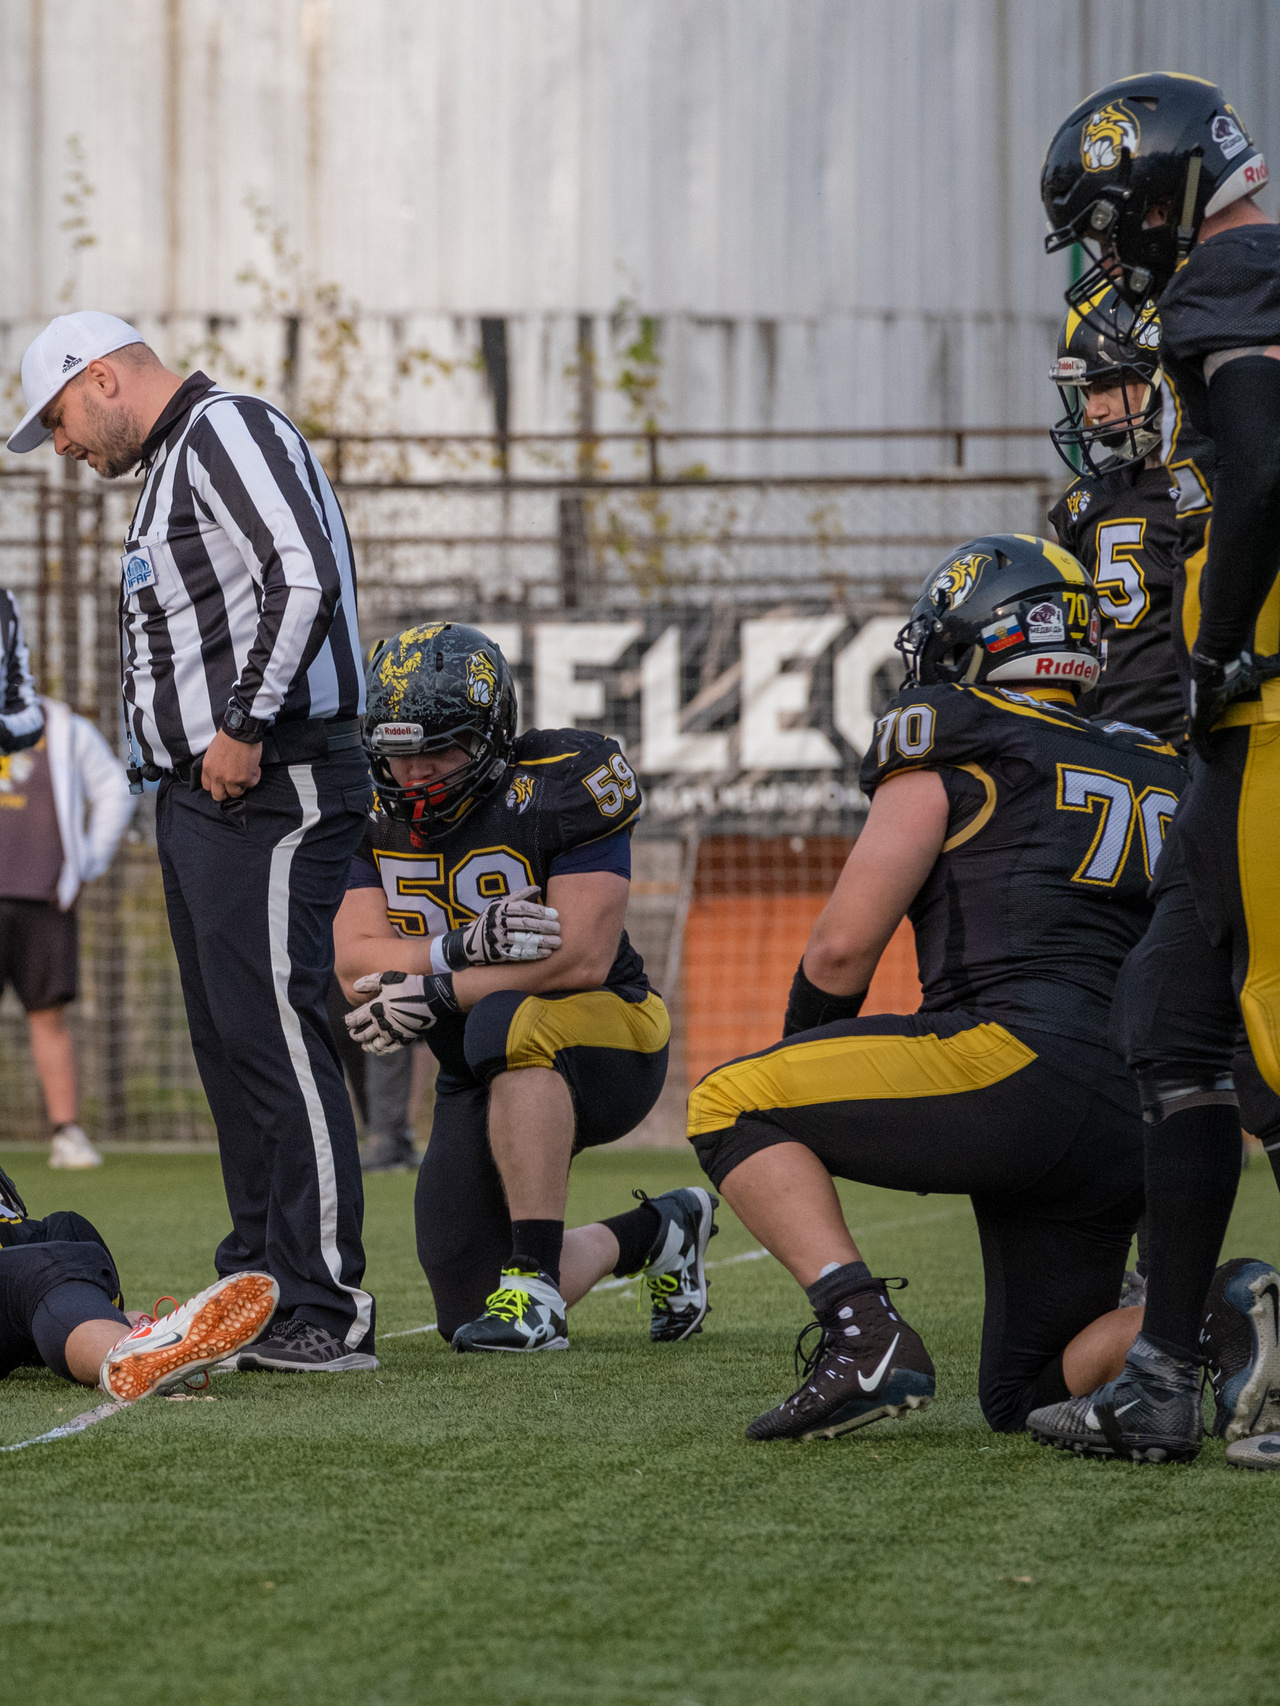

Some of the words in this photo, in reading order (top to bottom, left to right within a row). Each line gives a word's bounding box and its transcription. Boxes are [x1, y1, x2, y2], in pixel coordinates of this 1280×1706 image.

[62, 357, 82, 373] adidas
[128, 569, 152, 588] IFAF
[1094, 518, 1150, 629] 5
[1062, 592, 1089, 626] 70
[1035, 657, 1098, 681] Riddell
[384, 726, 412, 736] Riddell
[876, 703, 937, 768] 70
[582, 753, 638, 818] 59
[372, 845, 545, 940] 59
